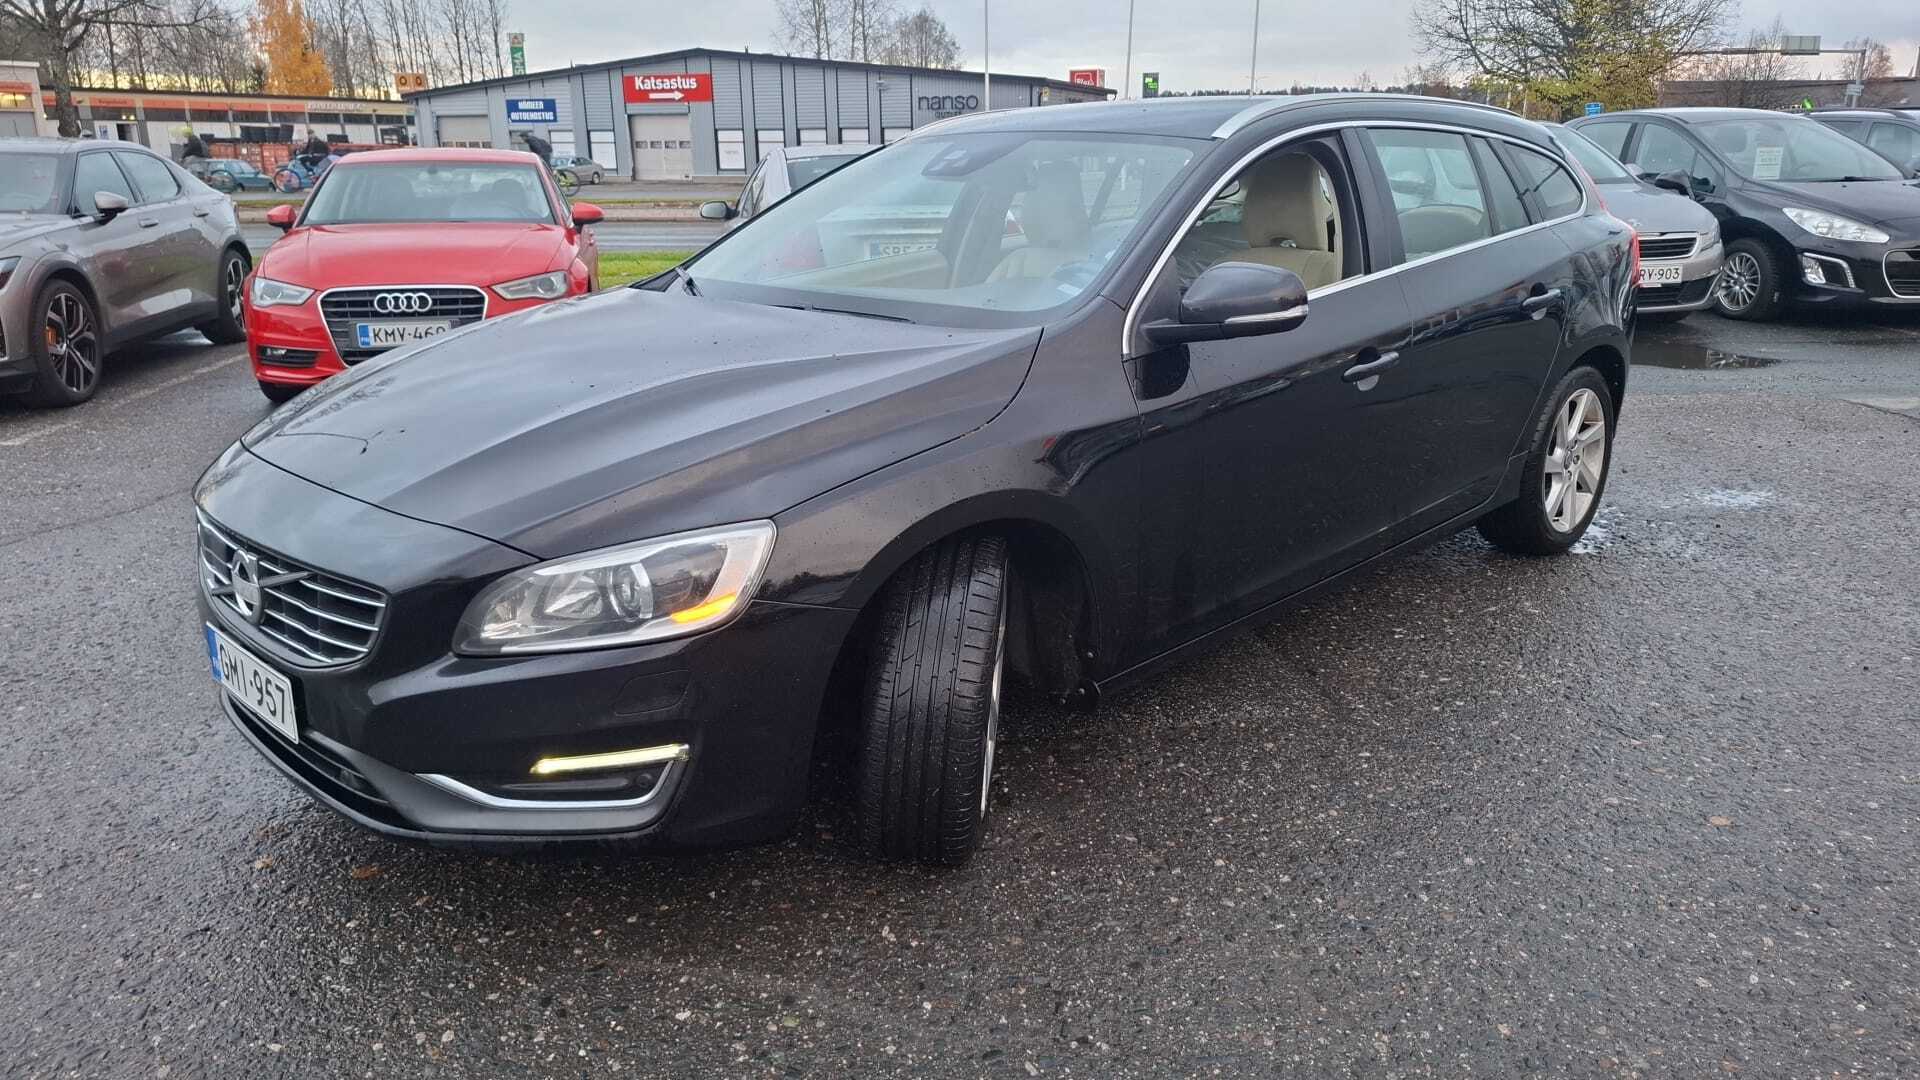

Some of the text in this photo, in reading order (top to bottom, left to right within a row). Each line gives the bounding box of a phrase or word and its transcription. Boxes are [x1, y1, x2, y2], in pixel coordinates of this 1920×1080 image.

[634, 76, 697, 91] Katsastus
[918, 94, 979, 111] nanso
[219, 643, 285, 725] GMI-957
